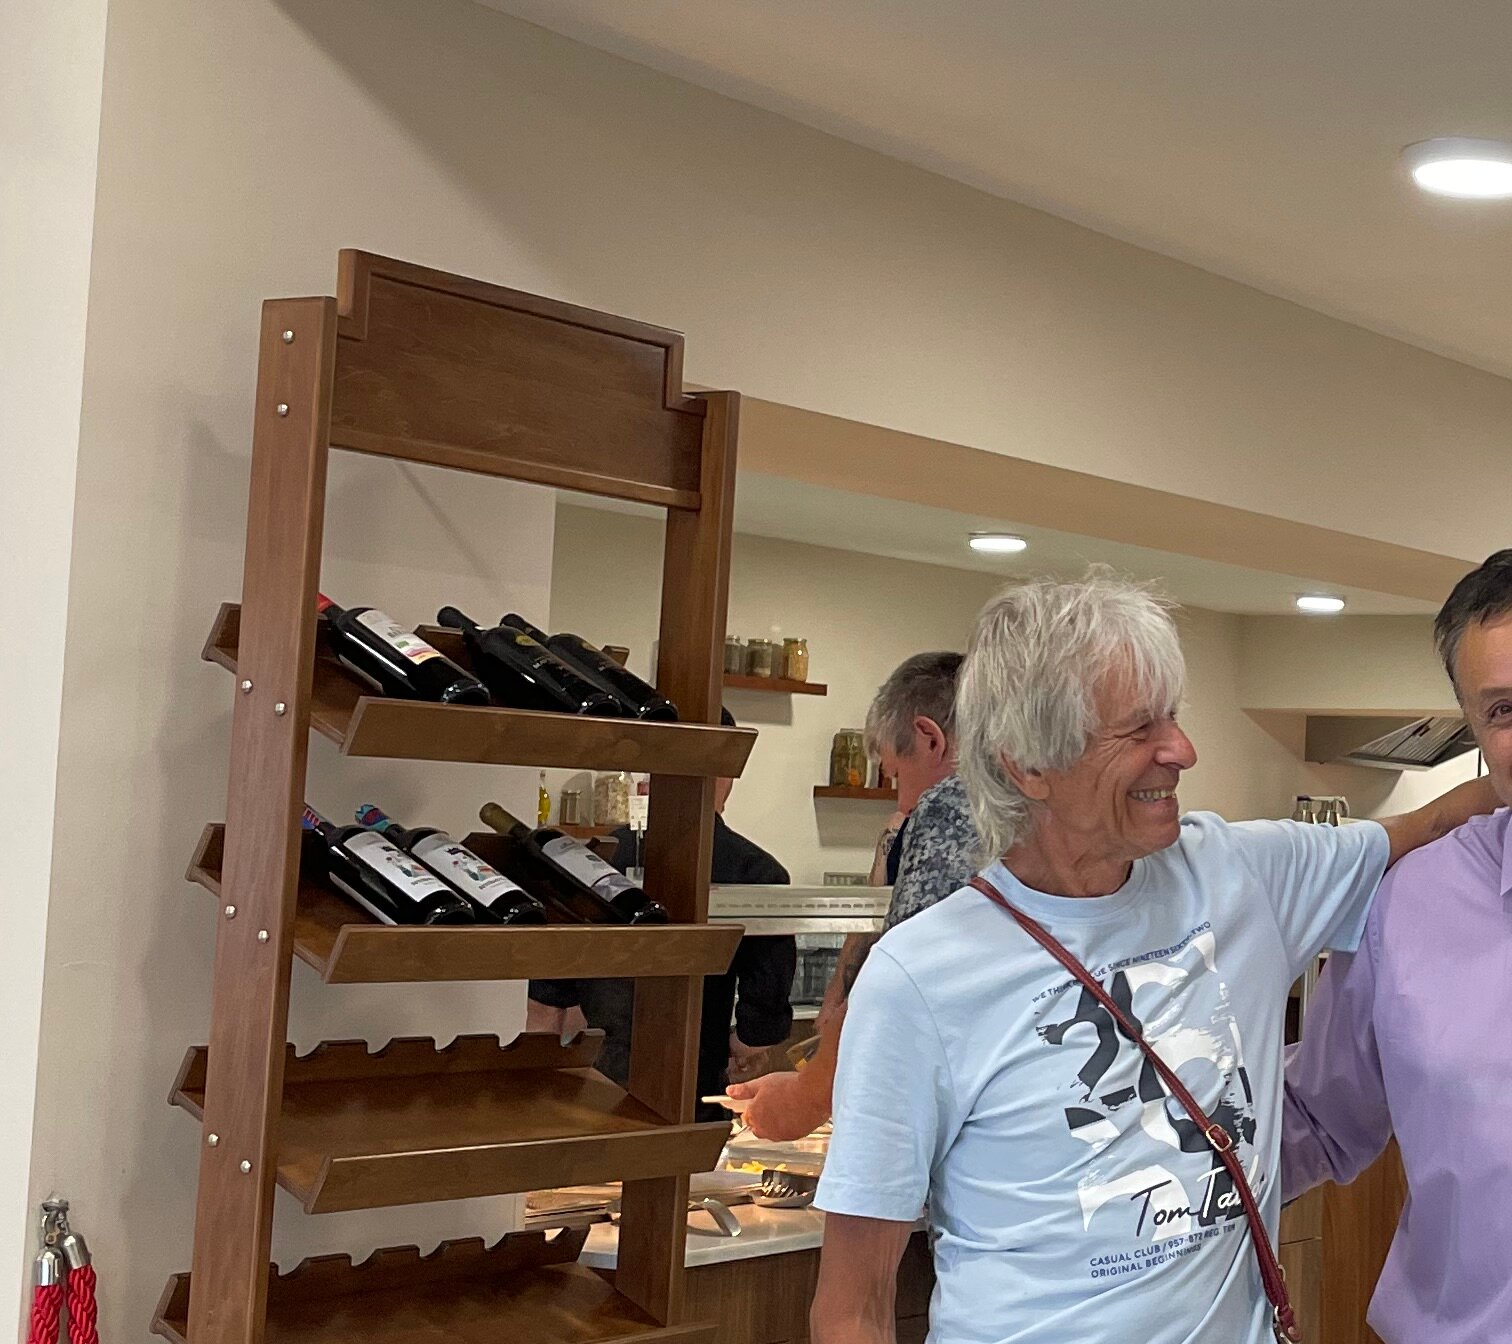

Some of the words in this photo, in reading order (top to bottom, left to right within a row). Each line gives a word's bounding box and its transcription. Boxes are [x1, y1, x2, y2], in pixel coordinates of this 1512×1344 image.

[1108, 958, 1131, 972] SINCE
[1131, 1179, 1199, 1237] Tom
[1090, 1253, 1132, 1267] CASUAL
[1134, 1244, 1161, 1259] CLUB
[1091, 1262, 1143, 1278] ORIGINAL
[1146, 1243, 1202, 1268] BEGINNINGS
